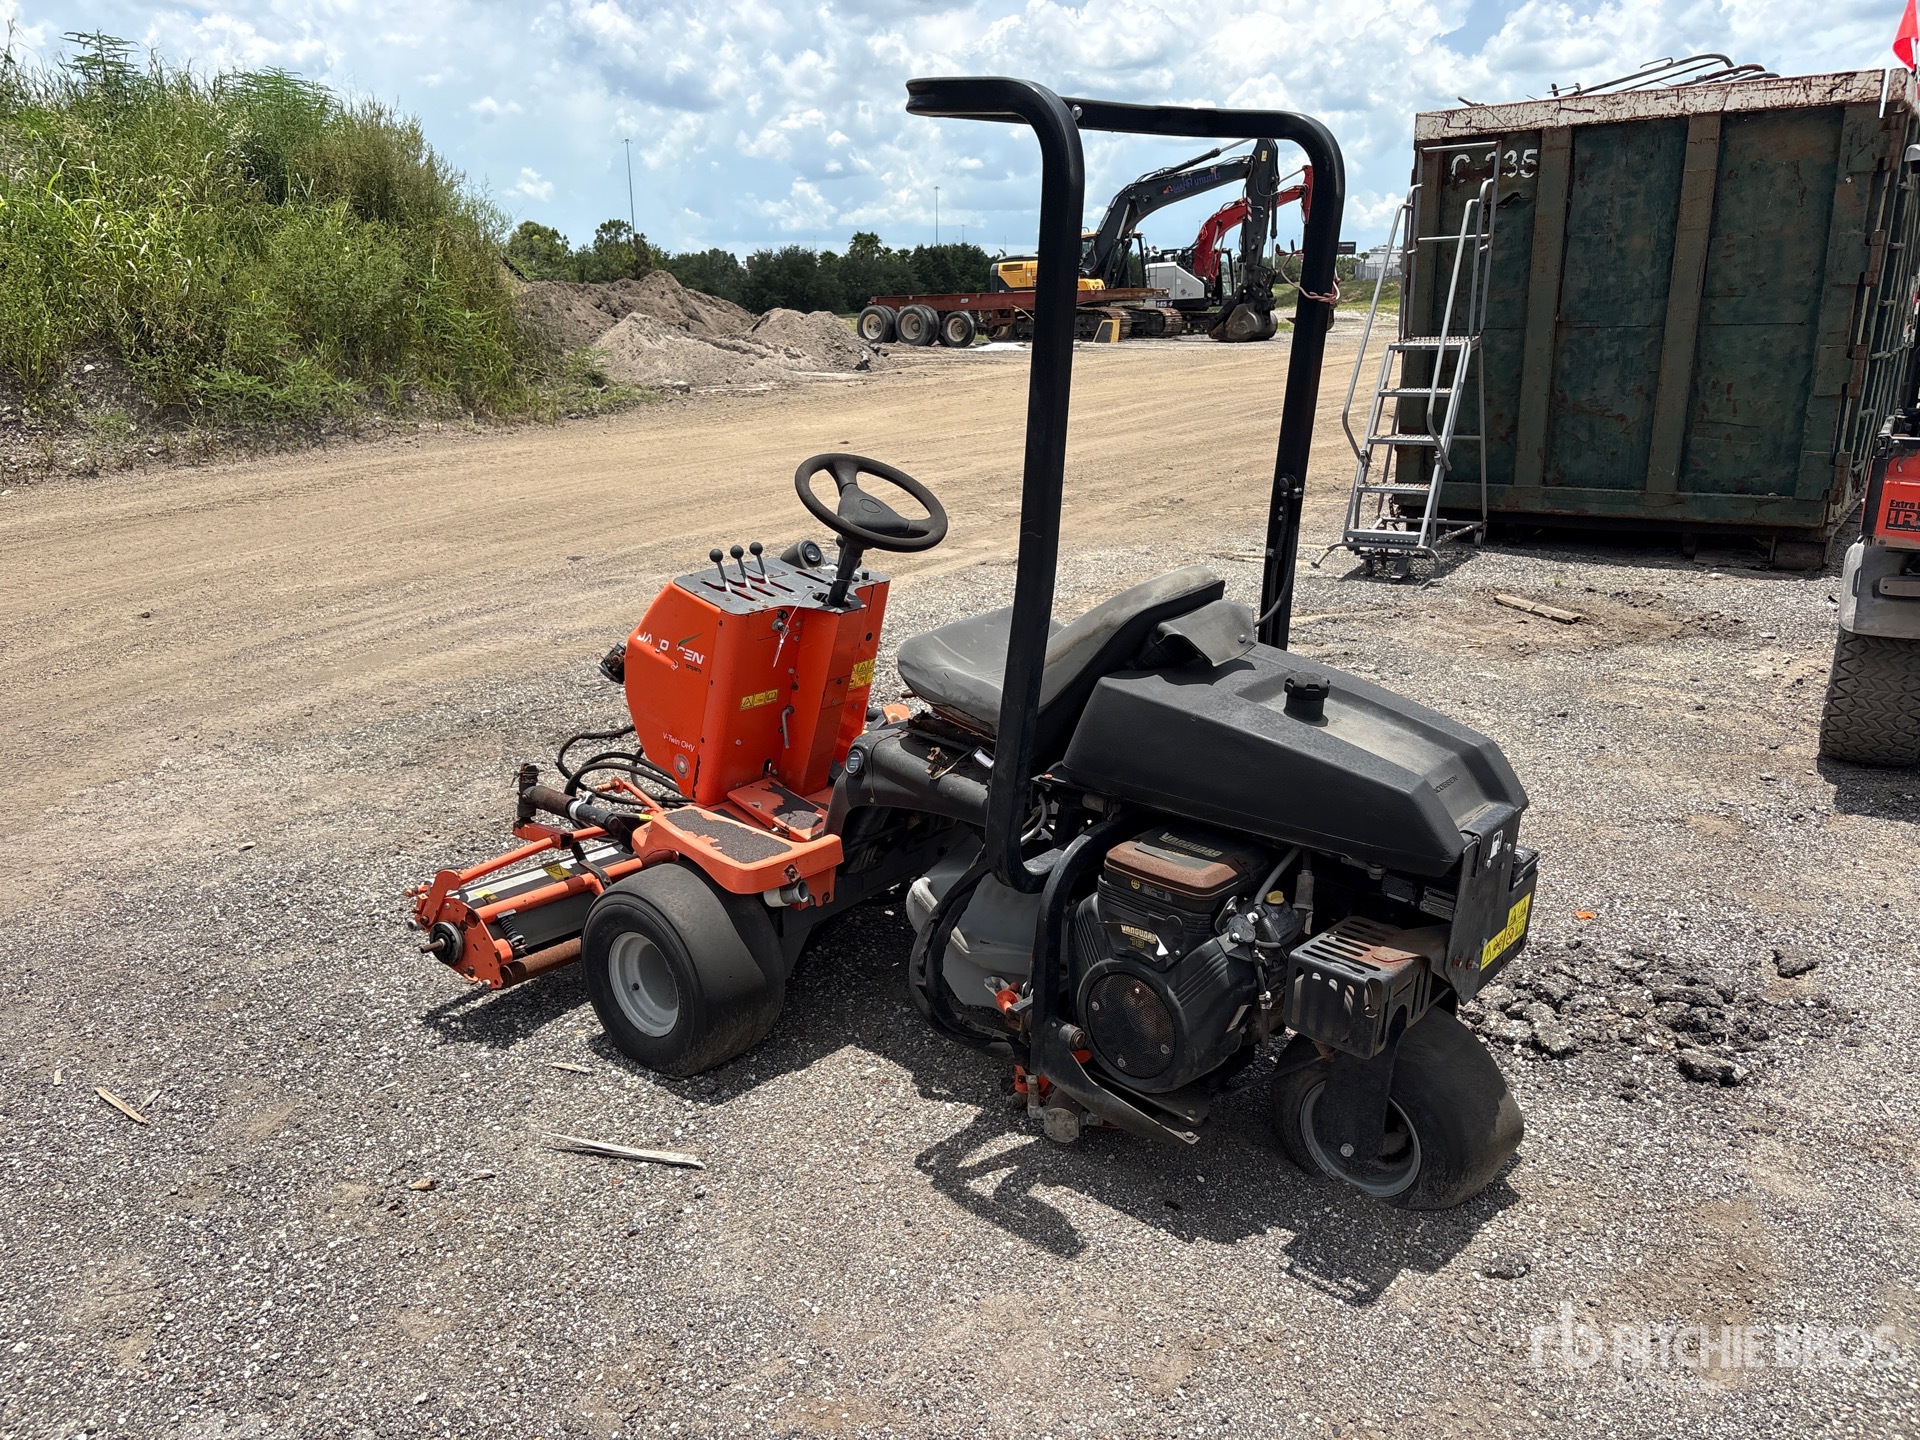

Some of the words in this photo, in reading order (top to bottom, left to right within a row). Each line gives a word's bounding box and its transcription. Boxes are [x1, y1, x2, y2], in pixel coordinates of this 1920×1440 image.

[1890, 499, 1915, 510] Extra
[662, 731, 680, 746] V-Twin
[681, 740, 695, 752] OHV
[1159, 832, 1223, 858] VANGUARD
